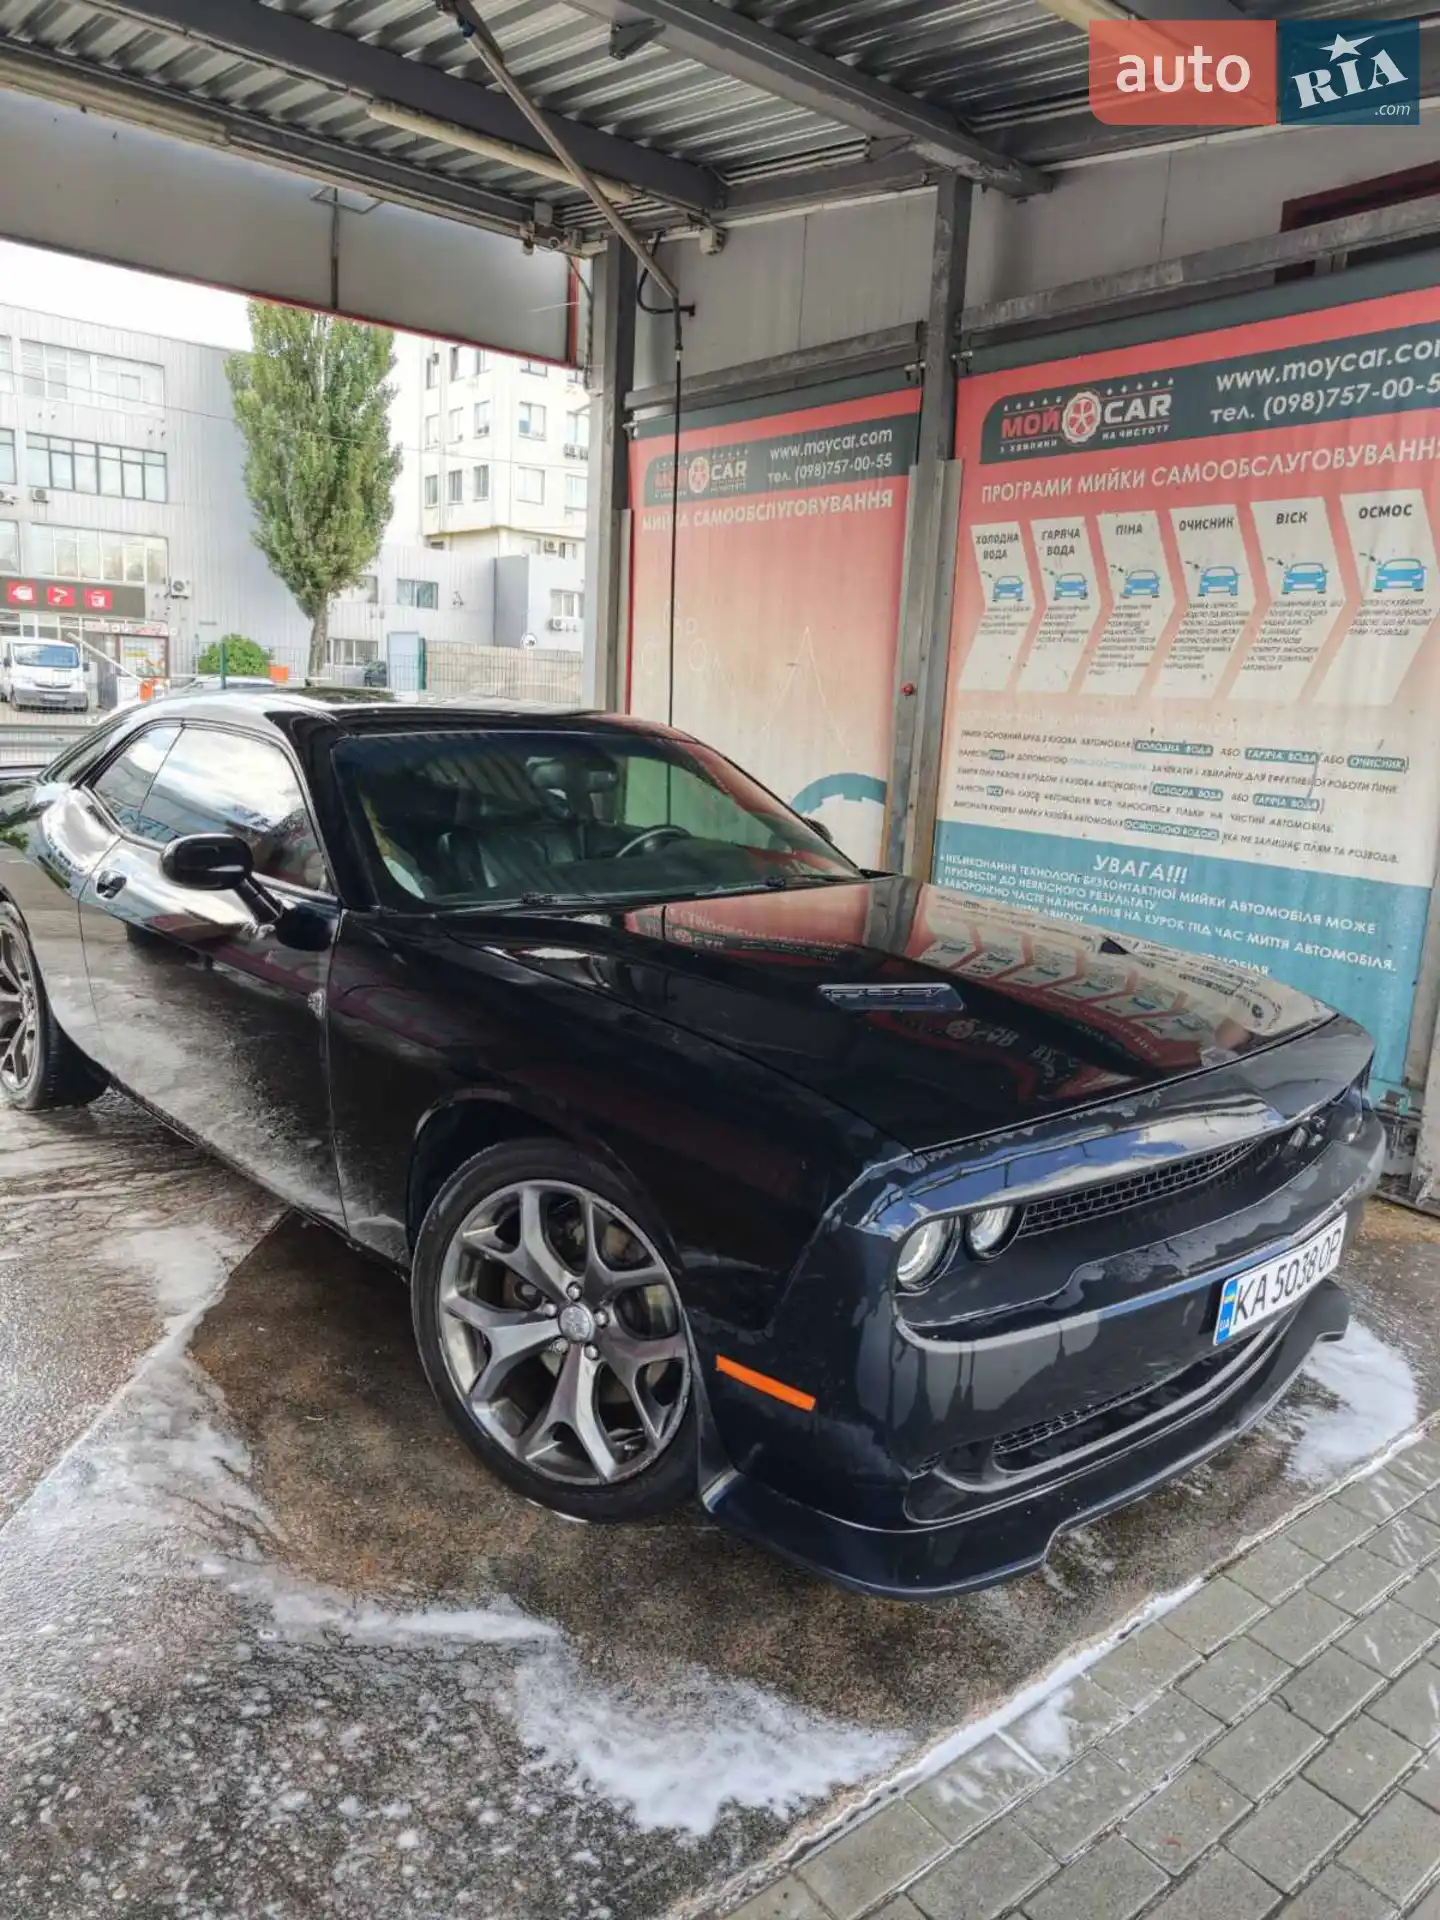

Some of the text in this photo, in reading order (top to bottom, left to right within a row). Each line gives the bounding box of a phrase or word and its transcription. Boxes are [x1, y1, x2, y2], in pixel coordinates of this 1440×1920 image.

[1215, 338, 1440, 392] www.moycar.co
[1103, 393, 1172, 424] CAR
[1210, 405, 1255, 423] тел.
[1001, 405, 1062, 438] МОЙ
[1118, 424, 1170, 439] ЧИСТОТУ
[769, 429, 893, 461] www.moycar.com
[710, 460, 747, 481] CAR
[794, 452, 893, 485] (098)757-00-55
[981, 476, 1073, 503] ПРОГРАМИ
[1077, 467, 1145, 494] МИЙКИ
[693, 488, 893, 527] САМООБСЛУГОВУВАННЯ
[1358, 504, 1413, 520] ОСМОС
[1178, 516, 1235, 532] ОЧИСНИК
[1275, 511, 1309, 525] ВІСК
[975, 531, 1020, 545] ХОЛОДНА
[1040, 527, 1081, 541] ГАРЯЧА
[1115, 523, 1144, 536] ПІНА
[983, 549, 1008, 560] ВОДА
[1046, 545, 1076, 557] ВОДА
[1219, 747, 1241, 758] АБО
[1092, 854, 1189, 885] УВАГА!!!
[999, 875, 1017, 887] ДО
[1179, 890, 1227, 909] МИЙКИ
[1229, 899, 1323, 926] АВТОМОБІЛЯ
[1324, 916, 1377, 935] МОЖЕ
[1011, 889, 1045, 903] ЧАСТЕ
[1046, 895, 1122, 919] НАТИСКАННЯ
[1124, 911, 1142, 923] НА
[1144, 914, 1185, 933] КУРОК
[1187, 920, 1213, 937] ПІД
[1214, 926, 1245, 942] ЧАС
[1246, 931, 1290, 950] МИТТЯ
[1293, 941, 1399, 973] АВТОМОБІЛЯ.
[1233, 1272, 1269, 1326] KA
[1271, 1245, 1319, 1305] 5038
